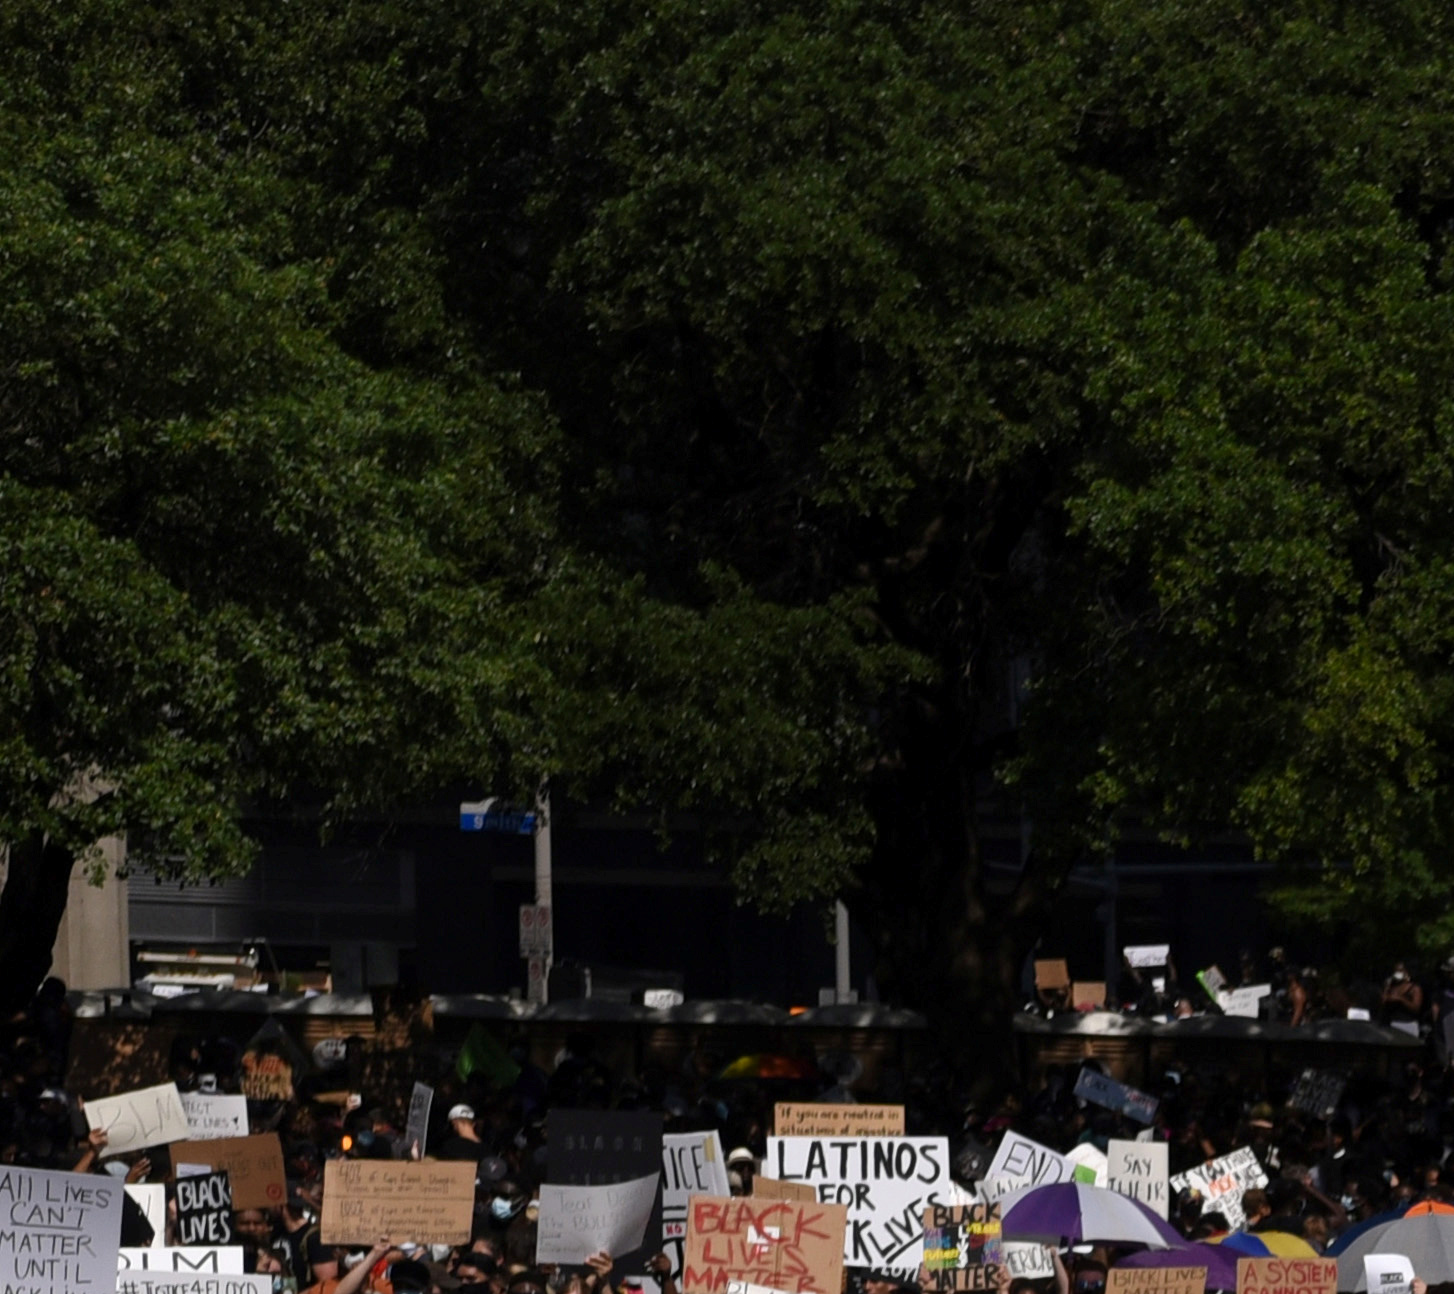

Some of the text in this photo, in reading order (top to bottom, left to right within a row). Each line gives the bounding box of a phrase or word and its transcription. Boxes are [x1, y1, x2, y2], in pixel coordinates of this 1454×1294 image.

[778, 1140, 941, 1184] LATINOS
[1123, 1154, 1153, 1178] SAY
[176, 1174, 230, 1212] BLACK
[819, 1184, 875, 1210] FOR
[10, 1204, 90, 1228] CAN'T
[180, 1211, 230, 1244] LIVES
[695, 1203, 831, 1243] BLACK
[869, 1192, 944, 1264] LIVES
[0, 1234, 97, 1258] MATTER
[703, 1238, 809, 1273] LIVES
[1164, 1268, 1206, 1282] LIVES
[1244, 1260, 1337, 1285] A SYSTEM
